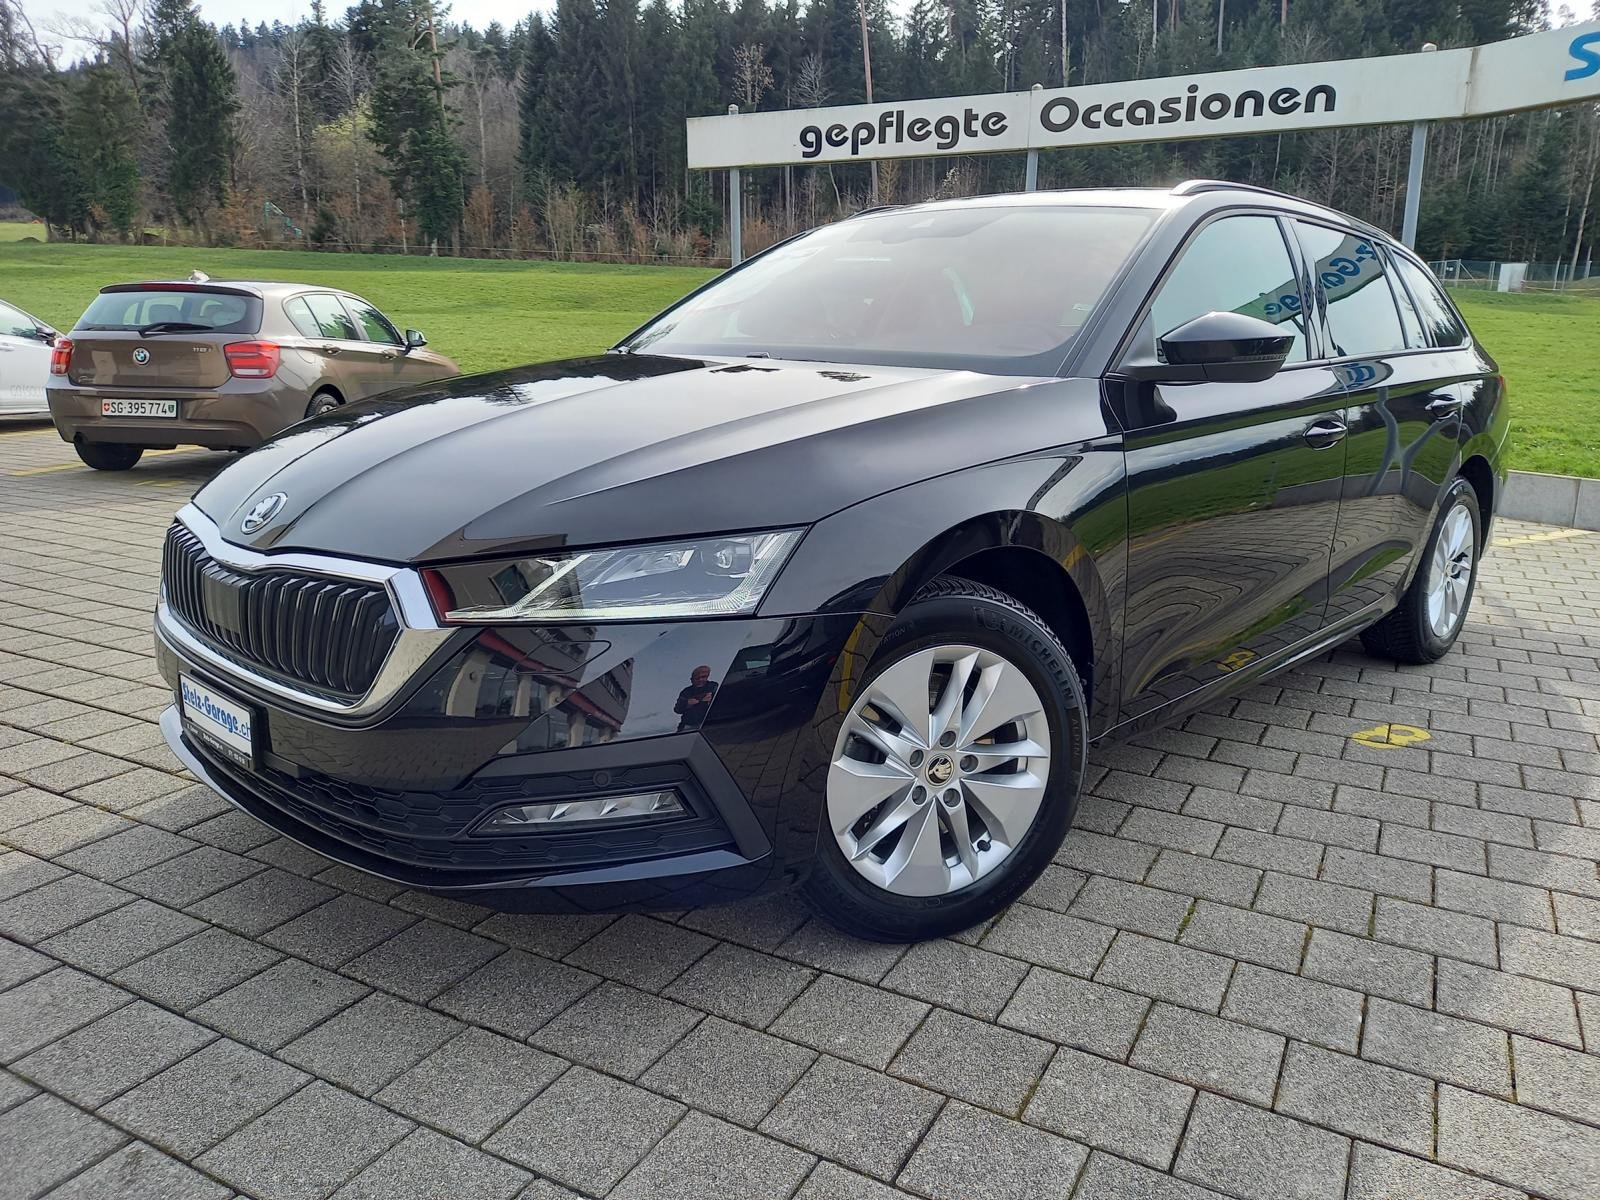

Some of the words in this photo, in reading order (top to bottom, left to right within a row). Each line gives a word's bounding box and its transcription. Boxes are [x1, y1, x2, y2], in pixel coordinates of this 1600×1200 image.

[799, 107, 1009, 157] gepflegte
[1041, 85, 1336, 133] Occasionen
[1009, 625, 1074, 699] MICHELIN
[182, 682, 251, 737] Stelz-Garage.ch
